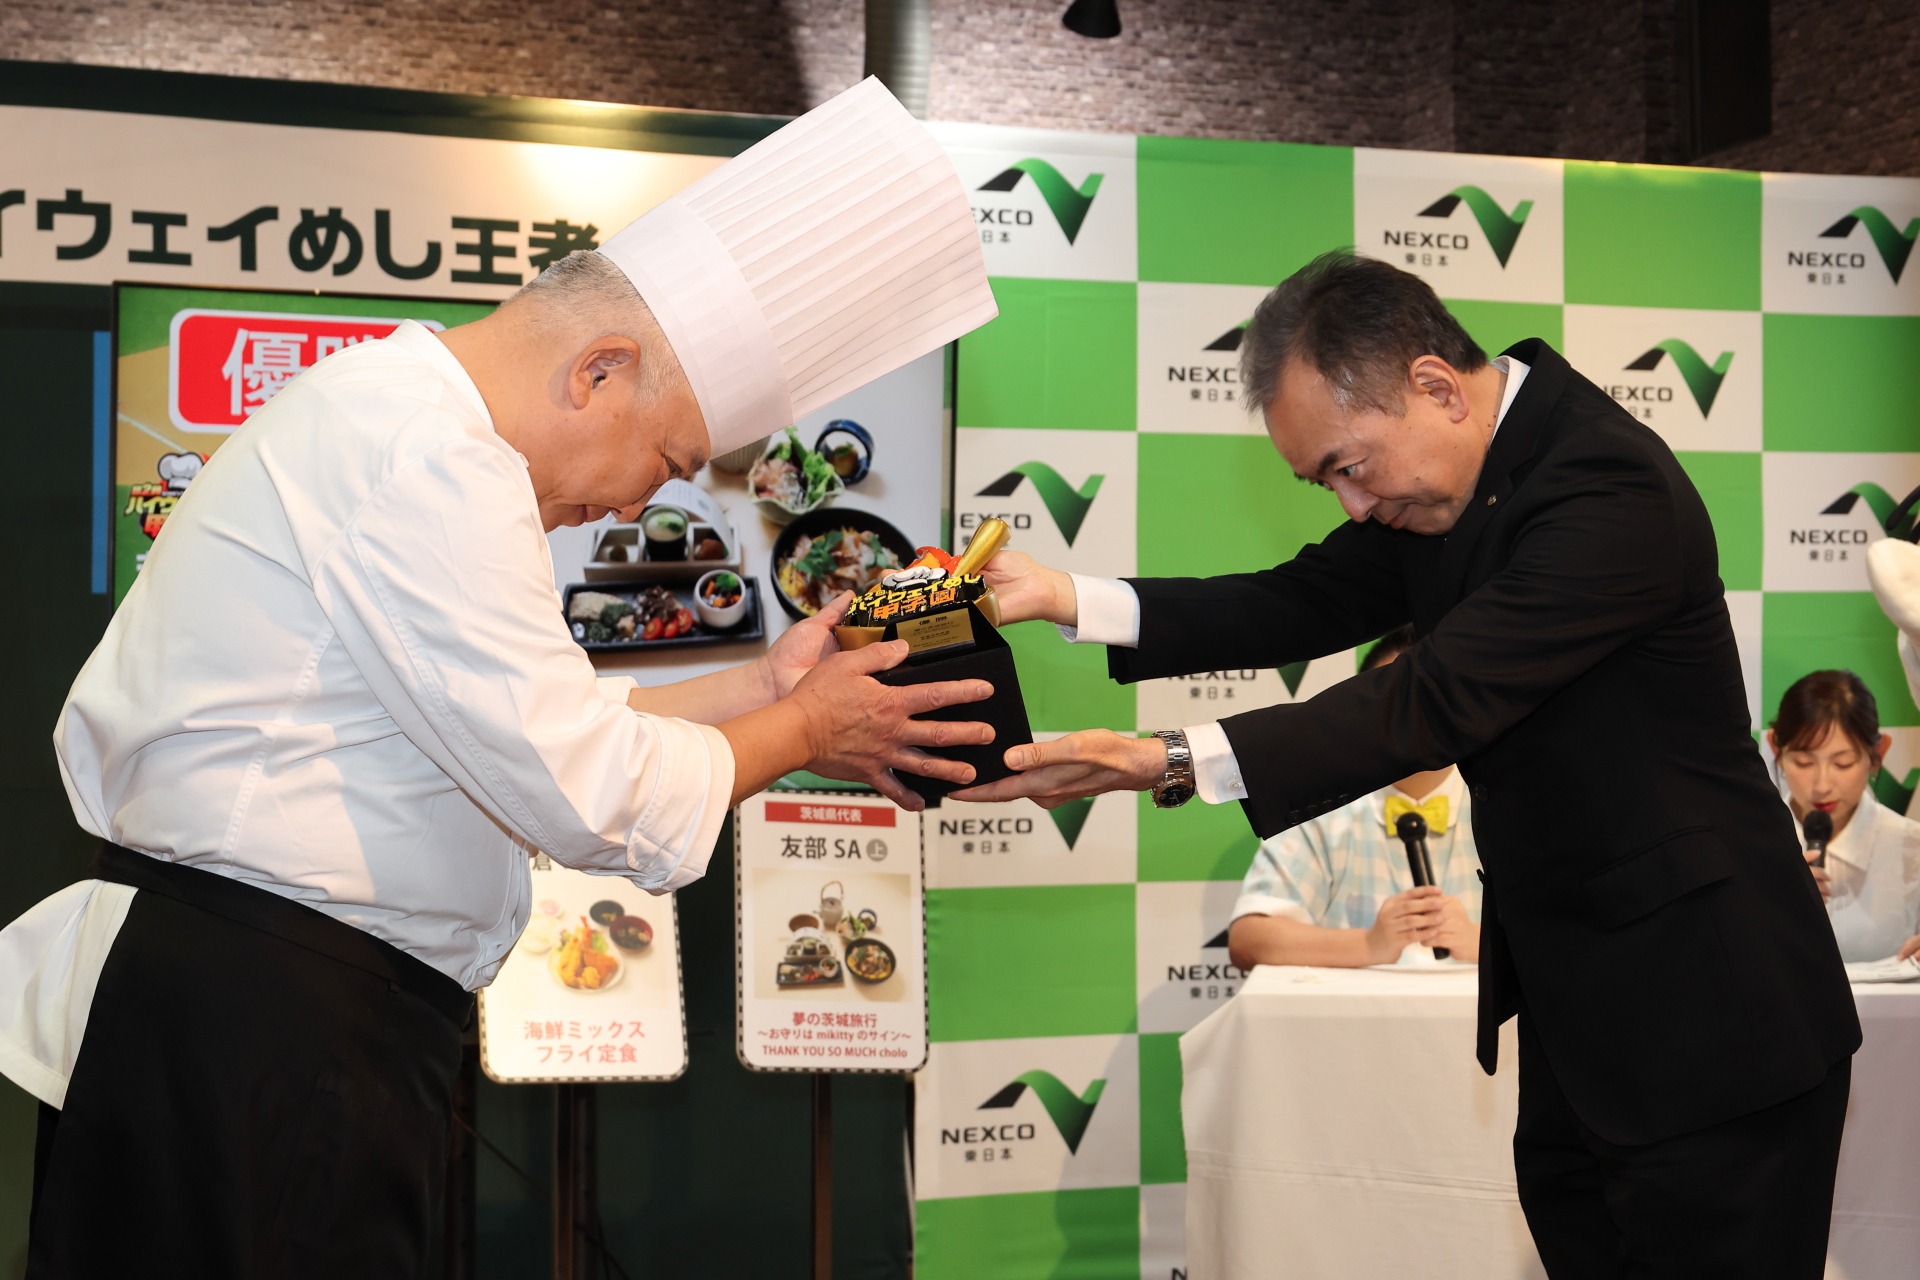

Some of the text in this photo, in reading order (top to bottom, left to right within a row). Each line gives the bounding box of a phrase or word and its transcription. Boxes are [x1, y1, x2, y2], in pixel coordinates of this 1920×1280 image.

[971, 207, 1033, 225] XCO
[0, 188, 599, 286] ウェイめし王者
[982, 229, 1011, 243] 日本
[1384, 230, 1468, 249] NEXCO
[1406, 253, 1448, 266] 東日本
[1788, 251, 1865, 268] NEXCO
[1806, 272, 1846, 285] 東日本
[1190, 388, 1235, 401] 東日本
[1628, 406, 1653, 418] 日本
[1790, 529, 1867, 544] NEXCO
[1809, 550, 1848, 562] 東日本
[847, 573, 981, 615] ハイウェイめし
[873, 587, 956, 619] 甲子園
[1190, 686, 1235, 699] 東日本
[800, 806, 862, 822] 茨城県代表
[940, 818, 1032, 835] NEXCO
[781, 835, 827, 859] 友部
[834, 839, 862, 859] SA
[962, 840, 1010, 854] 東日本
[1190, 986, 1235, 998] 東日本
[793, 1012, 877, 1028] 夢の茨城旅行
[524, 1020, 645, 1040] 海鮮ミックス
[816, 1029, 854, 1042] mikitty
[536, 1043, 638, 1063] フライ定食
[762, 1045, 907, 1058] THANK YOU SO MUCH cholo
[942, 1124, 1034, 1144] NEXCO
[965, 1148, 1013, 1162] 東日本
